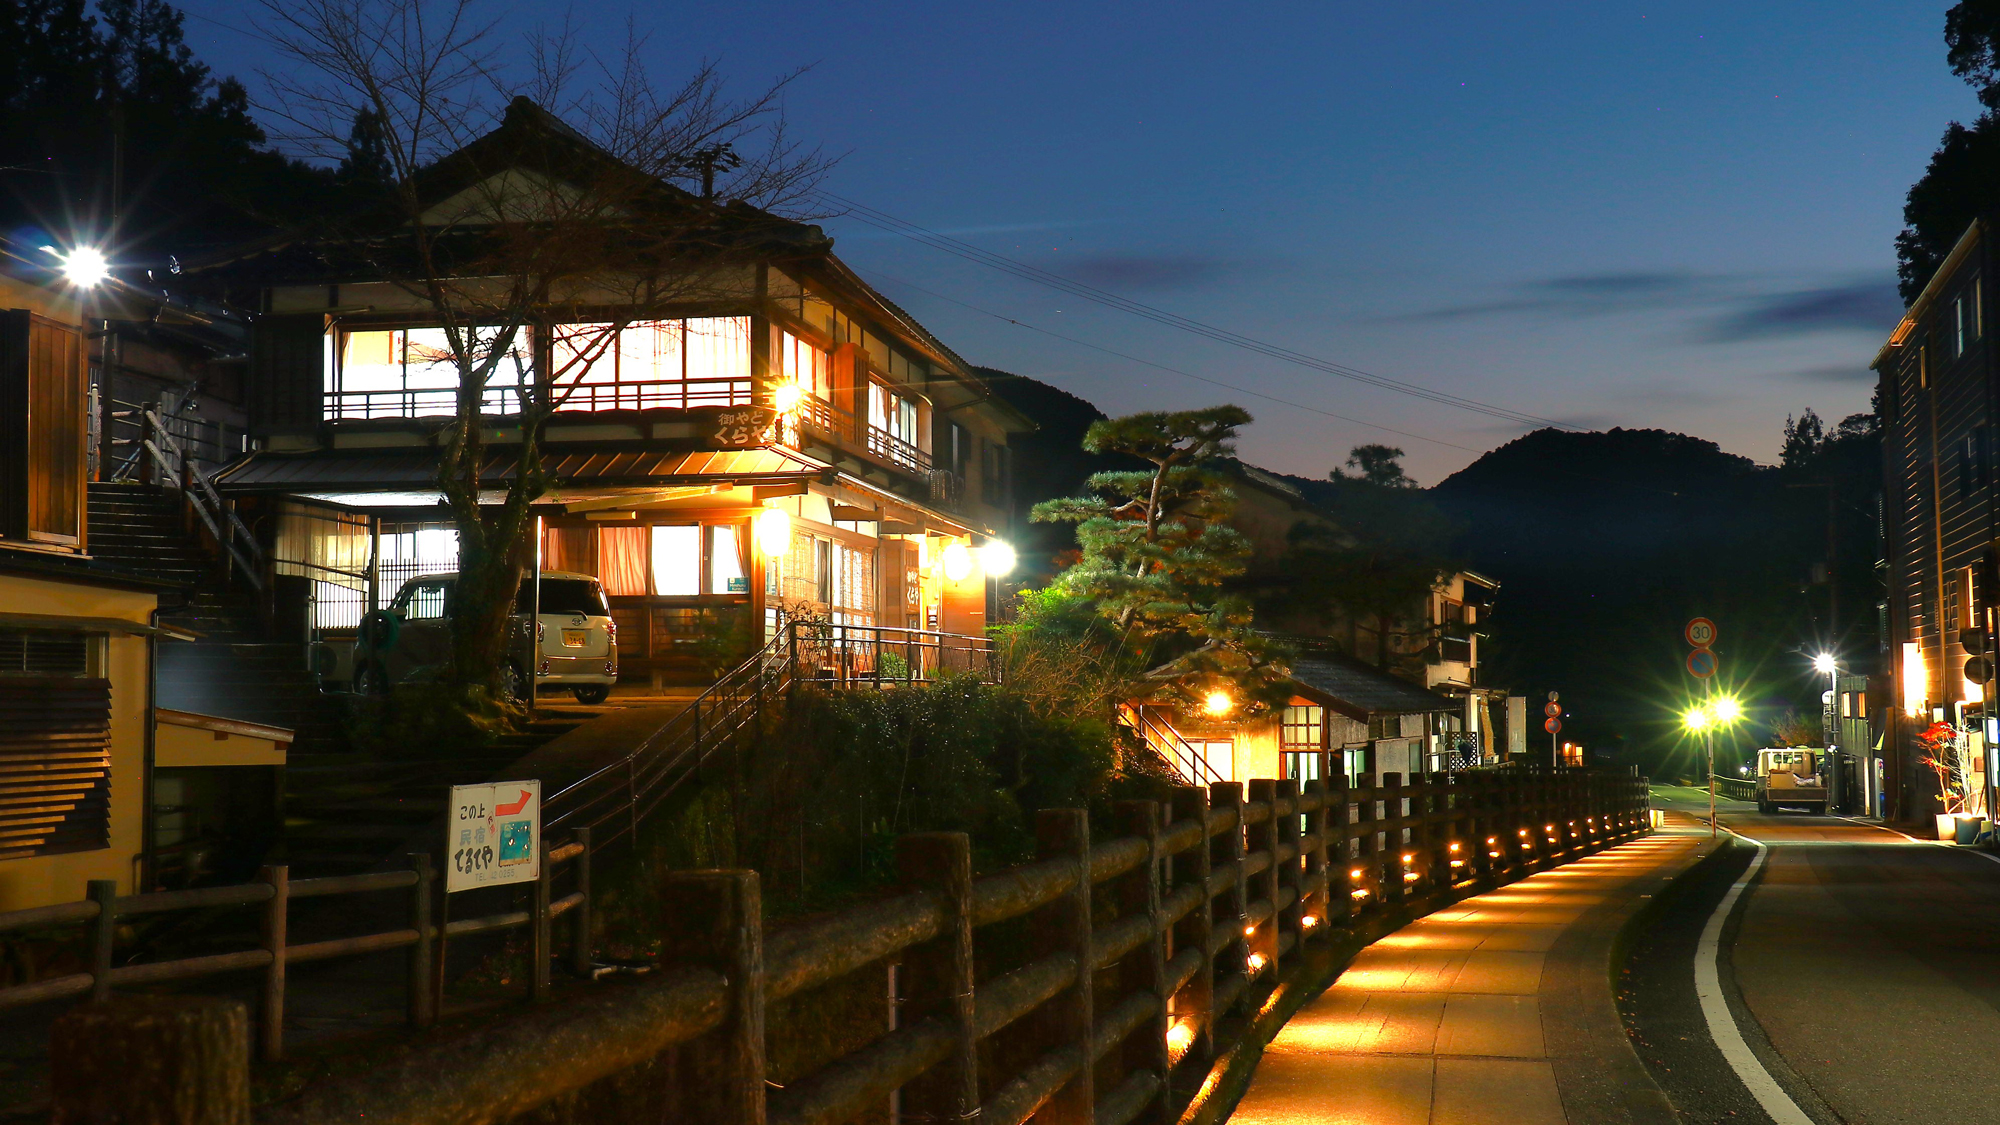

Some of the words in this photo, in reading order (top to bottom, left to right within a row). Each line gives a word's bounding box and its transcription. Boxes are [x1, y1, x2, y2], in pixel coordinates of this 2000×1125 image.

[718, 410, 763, 426] 御やど
[1692, 626, 1710, 640] 30
[460, 803, 485, 820] この上
[459, 826, 486, 846] 民宿
[454, 845, 494, 875] てるてや
